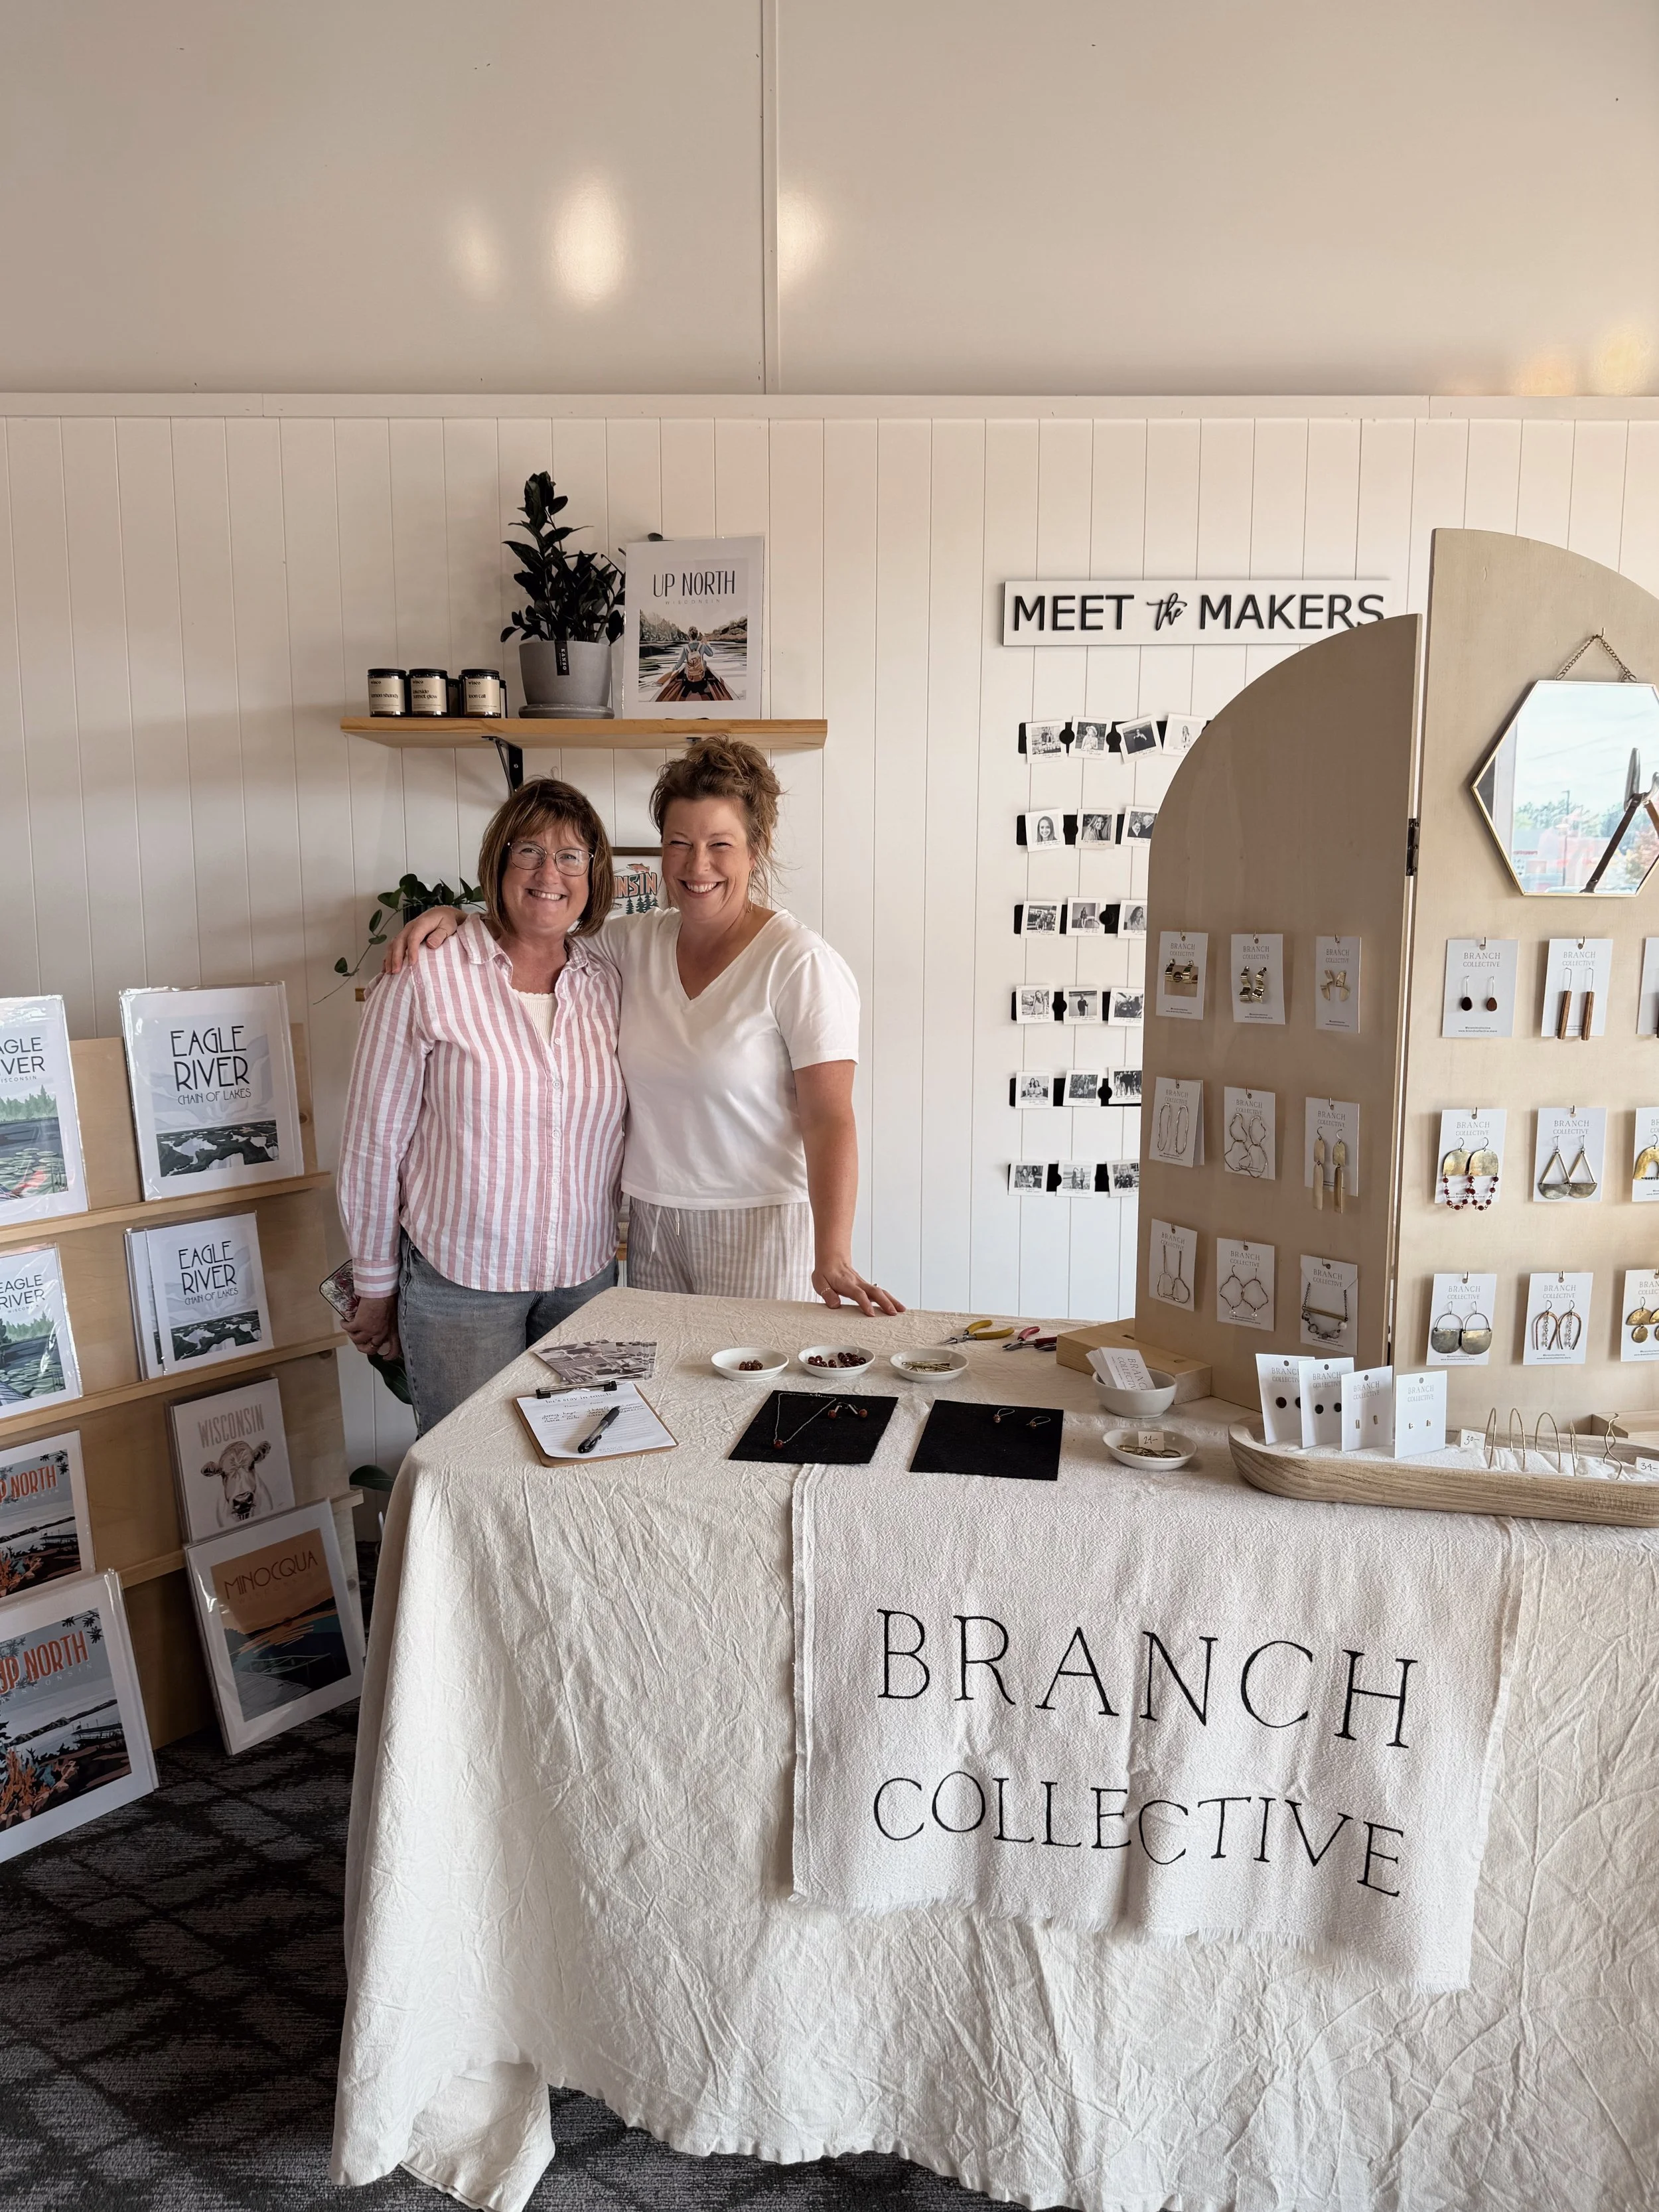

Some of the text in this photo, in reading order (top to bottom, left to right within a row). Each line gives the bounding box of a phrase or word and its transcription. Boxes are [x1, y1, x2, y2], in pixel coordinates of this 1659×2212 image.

[653, 570, 735, 597] UP NORTH
[1013, 593, 1384, 631] MEET the MAKERS
[0, 1037, 42, 1055] GLE
[171, 1025, 246, 1057] EAGLE
[0, 1056, 45, 1074] VER
[174, 1056, 250, 1092] RIVER
[178, 1088, 252, 1105] CHAIN OF LAKES
[1236, 1099, 1262, 1108] BRANCH
[1318, 1111, 1345, 1120] BRANCH
[179, 1240, 234, 1270] EAGLE
[1230, 1250, 1260, 1261] BRANCH
[181, 1264, 237, 1295] RIVER
[1313, 1269, 1342, 1280] BRANCH
[184, 1288, 238, 1305] CHAIN OF LAKES
[1128, 1358, 1154, 1390] BRANC
[198, 1404, 264, 1449] WISCONSIN
[11, 1464, 57, 1499] NORTH
[224, 1550, 319, 1599] MINOCQUA
[23, 1630, 88, 1683] NORTH
[877, 1608, 1418, 1749] BRANCH
[873, 1771, 1405, 1898] COLLECTIVE
